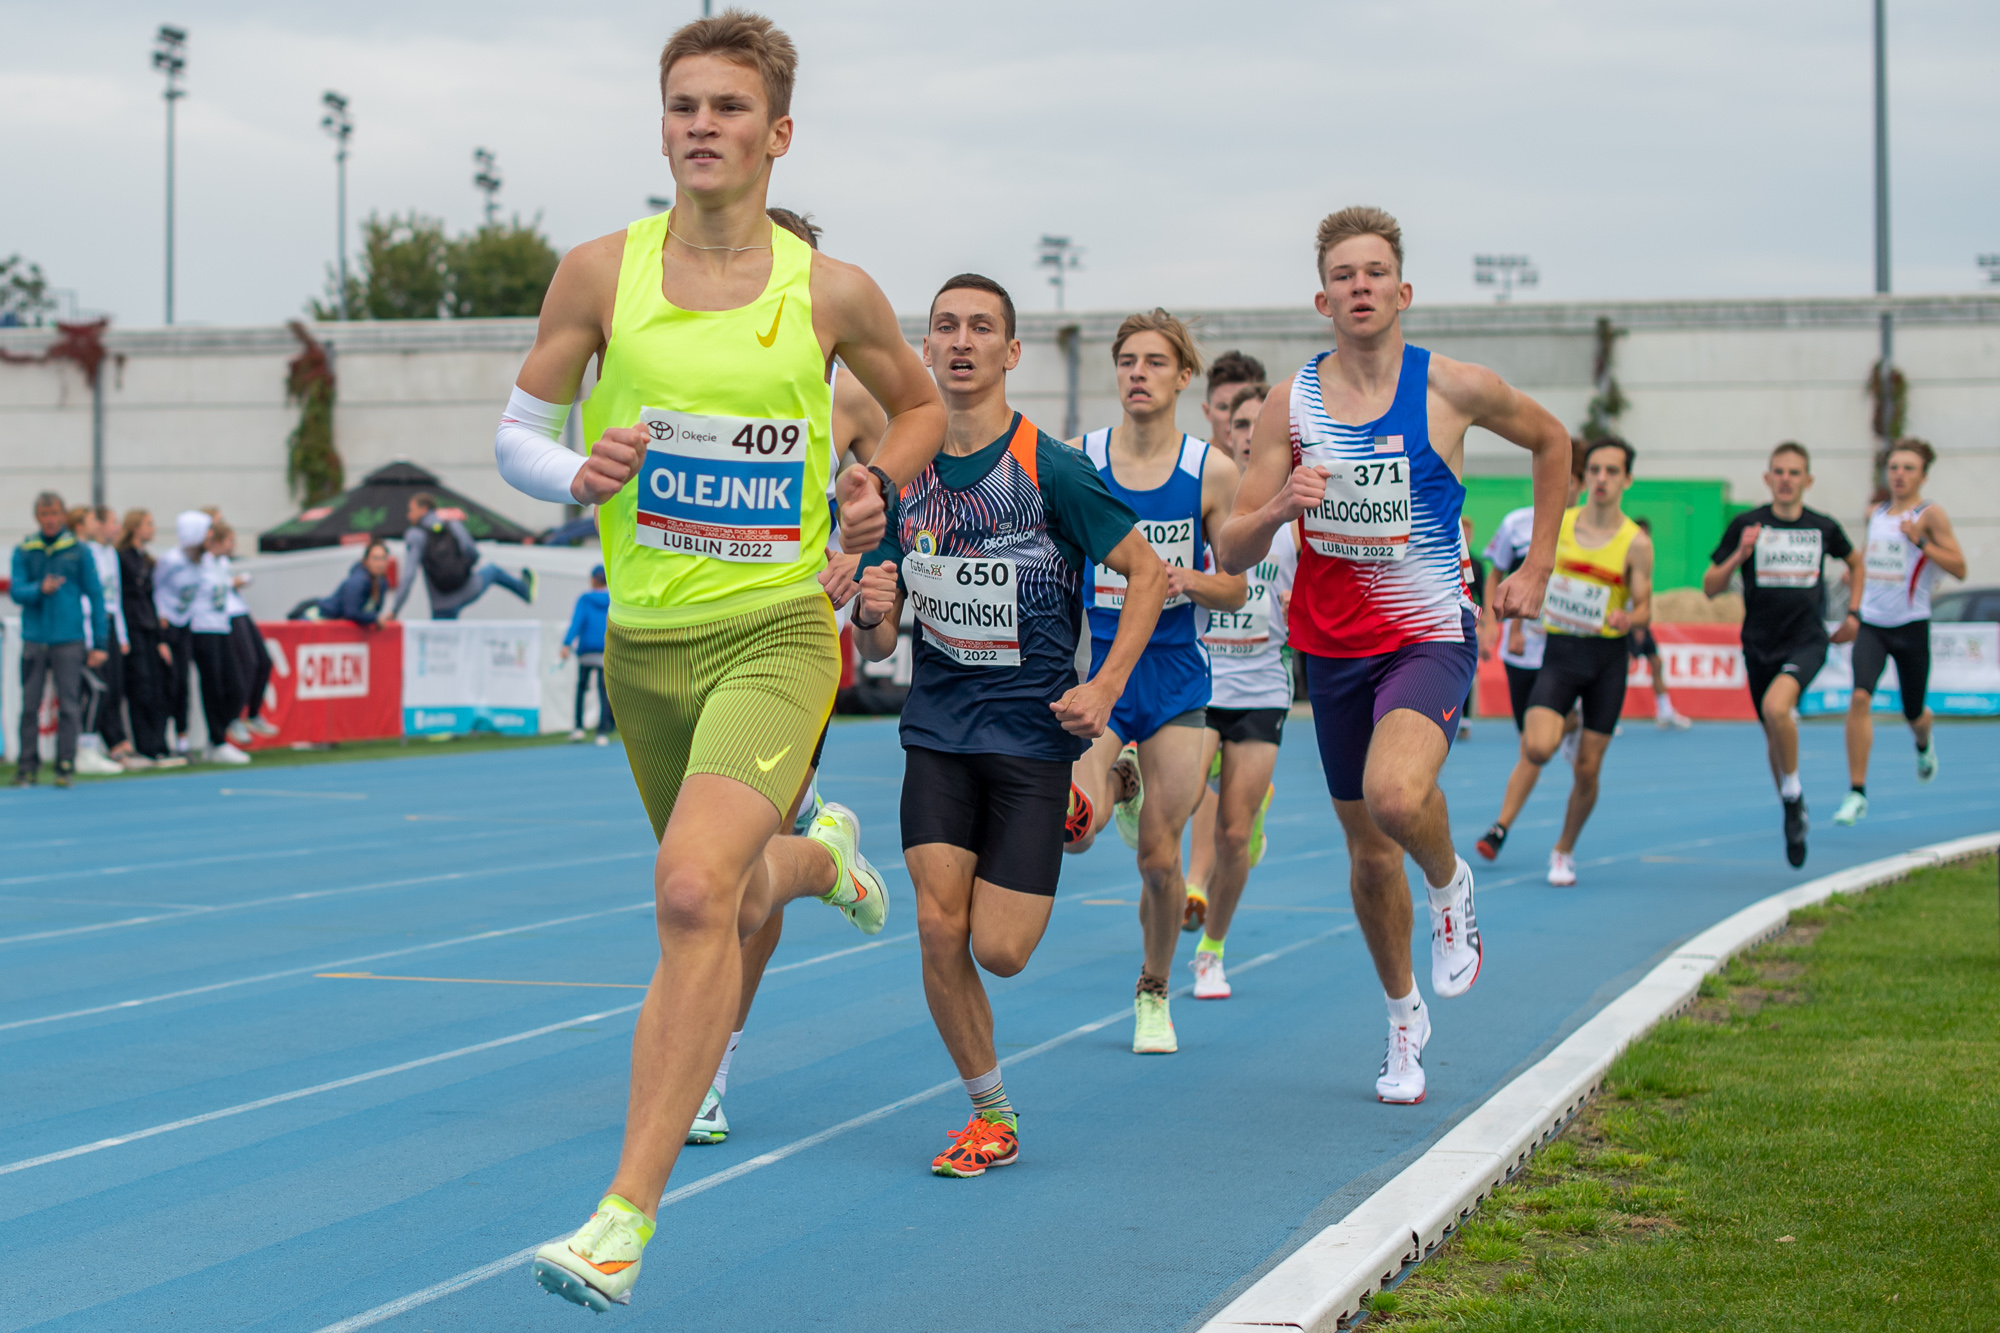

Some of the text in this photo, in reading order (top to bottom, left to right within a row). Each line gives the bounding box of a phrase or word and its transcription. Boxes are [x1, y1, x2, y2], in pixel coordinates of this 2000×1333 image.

[682, 430, 717, 443] Okęcie
[732, 424, 800, 455] 409
[1353, 462, 1403, 486] 371
[650, 467, 792, 510] OLEJNIK
[664, 532, 773, 558] LUBLIN 2022
[984, 528, 1036, 549] DECATHLON
[1143, 523, 1190, 544] 1022
[1322, 541, 1394, 557] LUBLIN 2022
[956, 563, 1009, 586] 650
[911, 590, 1013, 628] OKRUCIŃSKI
[1209, 612, 1253, 629] EETZ
[964, 650, 998, 660] 2022
[304, 654, 364, 688] ORLEN
